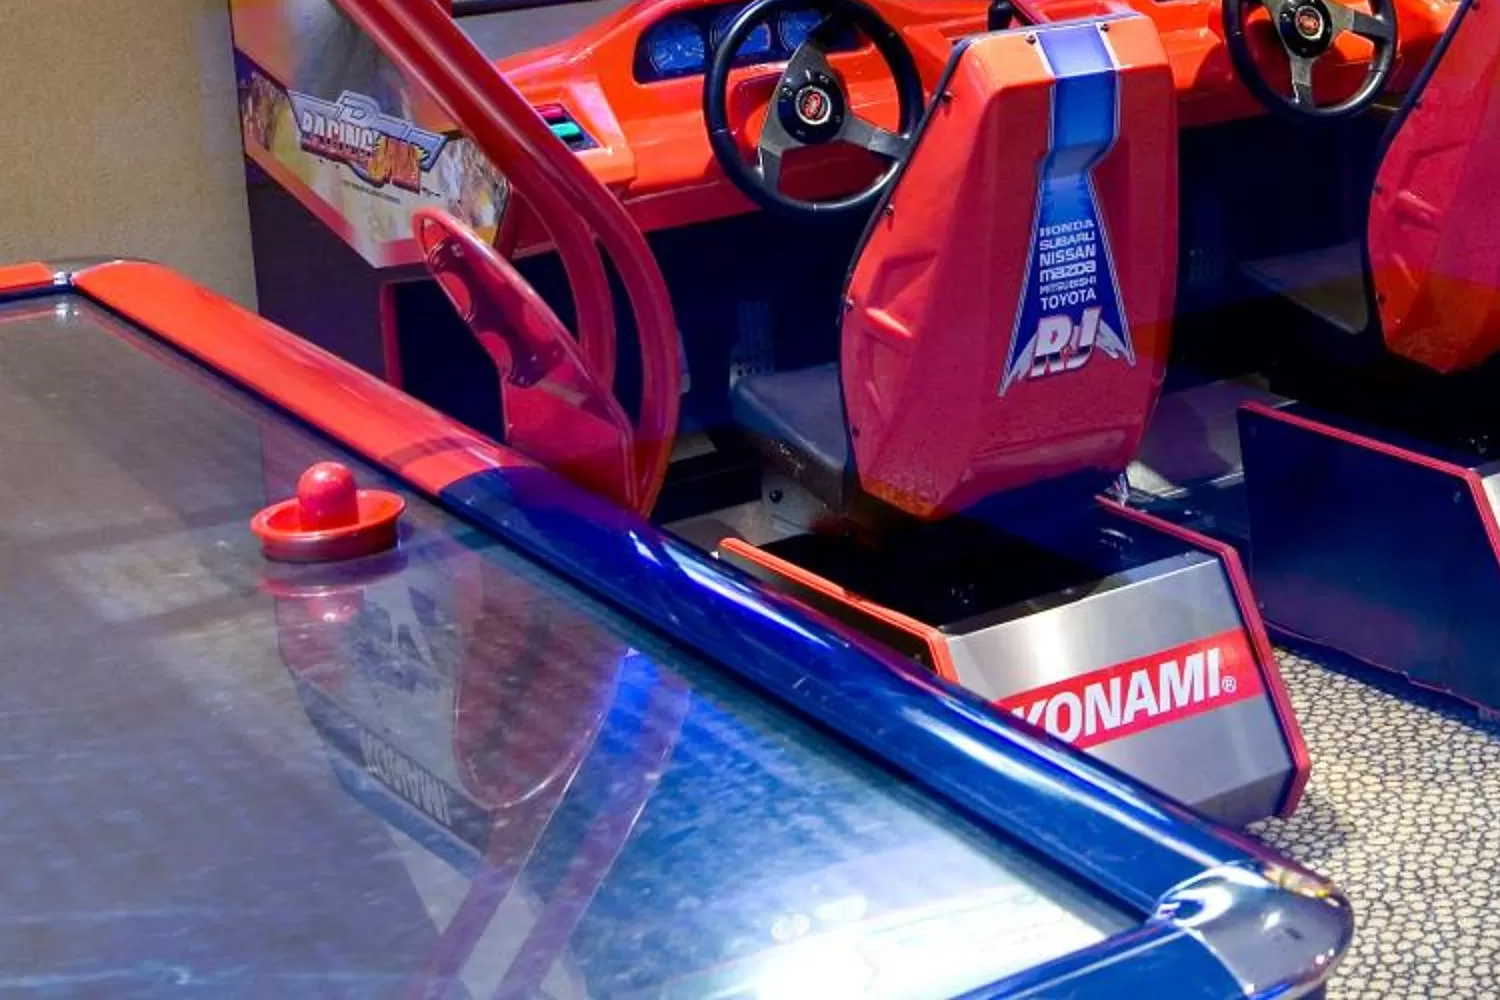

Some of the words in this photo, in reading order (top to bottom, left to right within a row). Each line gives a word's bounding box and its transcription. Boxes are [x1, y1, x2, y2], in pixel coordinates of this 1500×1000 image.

[1040, 219, 1095, 238] HONDA
[1039, 243, 1097, 267] NISSAN
[1040, 287, 1097, 311] TOYOTA
